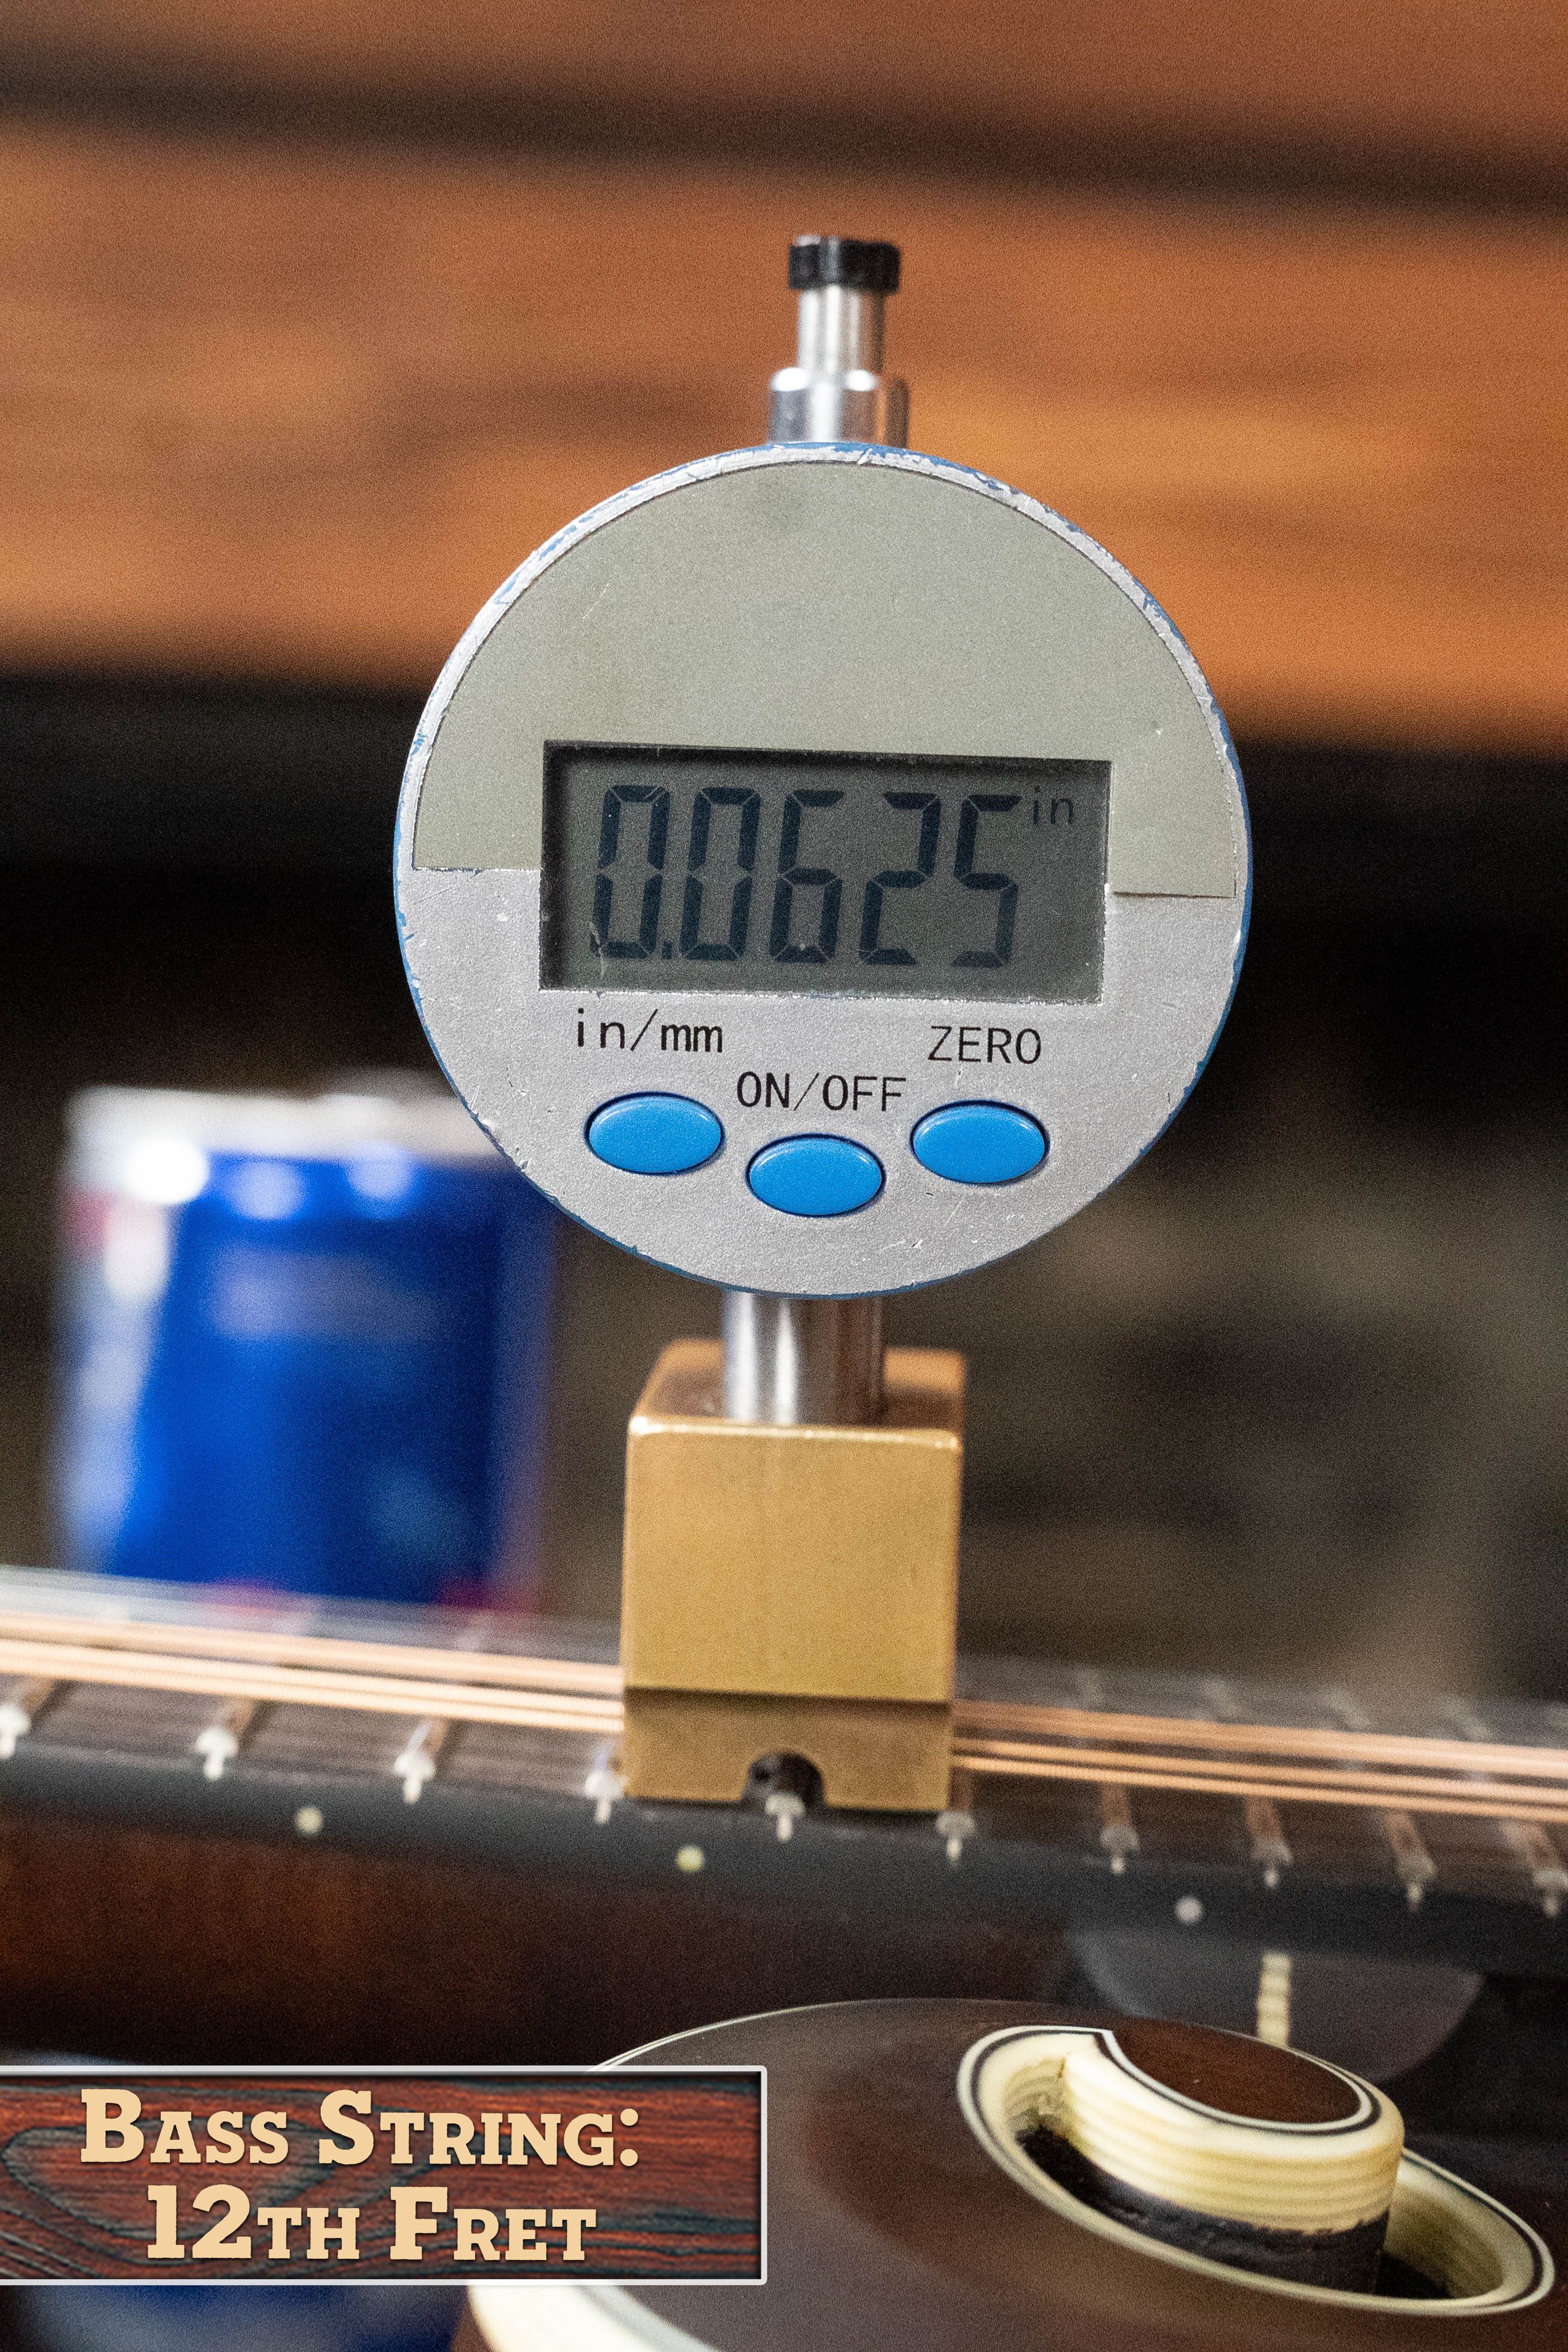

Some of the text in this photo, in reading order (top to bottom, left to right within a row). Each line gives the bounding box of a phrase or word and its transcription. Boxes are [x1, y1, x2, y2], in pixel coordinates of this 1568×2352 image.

[590, 785, 1074, 967] 0.0625 in
[577, 1007, 723, 1054] in/mm
[927, 1025, 1042, 1065] ZERO
[736, 1071, 907, 1112] ON/OFF
